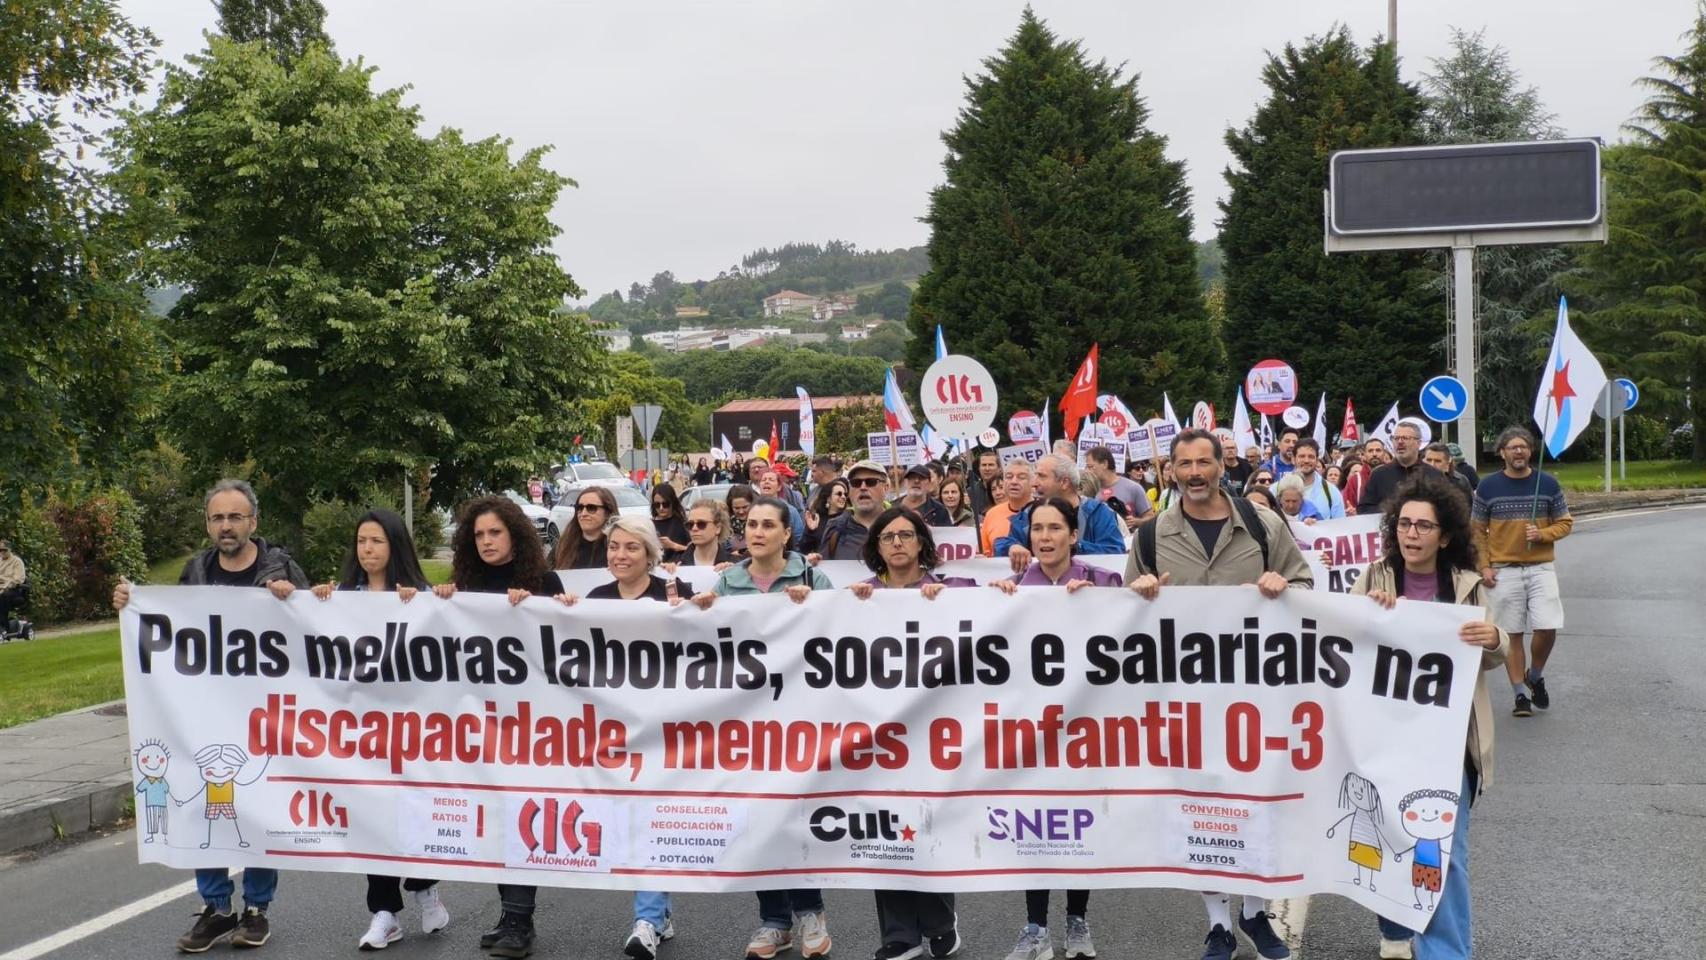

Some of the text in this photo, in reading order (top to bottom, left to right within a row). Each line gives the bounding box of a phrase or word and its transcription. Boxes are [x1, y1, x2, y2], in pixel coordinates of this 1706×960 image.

[936, 374, 982, 404] CIG
[949, 412, 974, 421] ENSINO
[138, 613, 1454, 708] Polas melloras laborais, sociais e salariais na
[248, 694, 1325, 782] discapacidade, menores e infantil 0-3
[433, 796, 468, 807] MENOS
[289, 790, 348, 828] CIG
[656, 805, 728, 815] CONSELLEIRA
[1181, 803, 1249, 818] CONVENIOS
[431, 812, 468, 823] RATIOS
[518, 798, 602, 857] CIG
[651, 820, 723, 831] NEGOCIACIÓN
[987, 806, 1094, 842] SNEP
[1193, 820, 1239, 832] DIGNOS
[294, 836, 321, 844] ENSINO
[657, 837, 727, 847] PUBLICIDADE
[1187, 835, 1245, 849] SALARIOS
[424, 844, 468, 855] PERSOAL
[850, 843, 915, 853] Central Unitaria
[525, 853, 597, 868] Autonómica
[660, 853, 714, 864] DOTACIÓN
[862, 851, 914, 861] Traballadoras
[1189, 852, 1236, 865] XUSTOS
